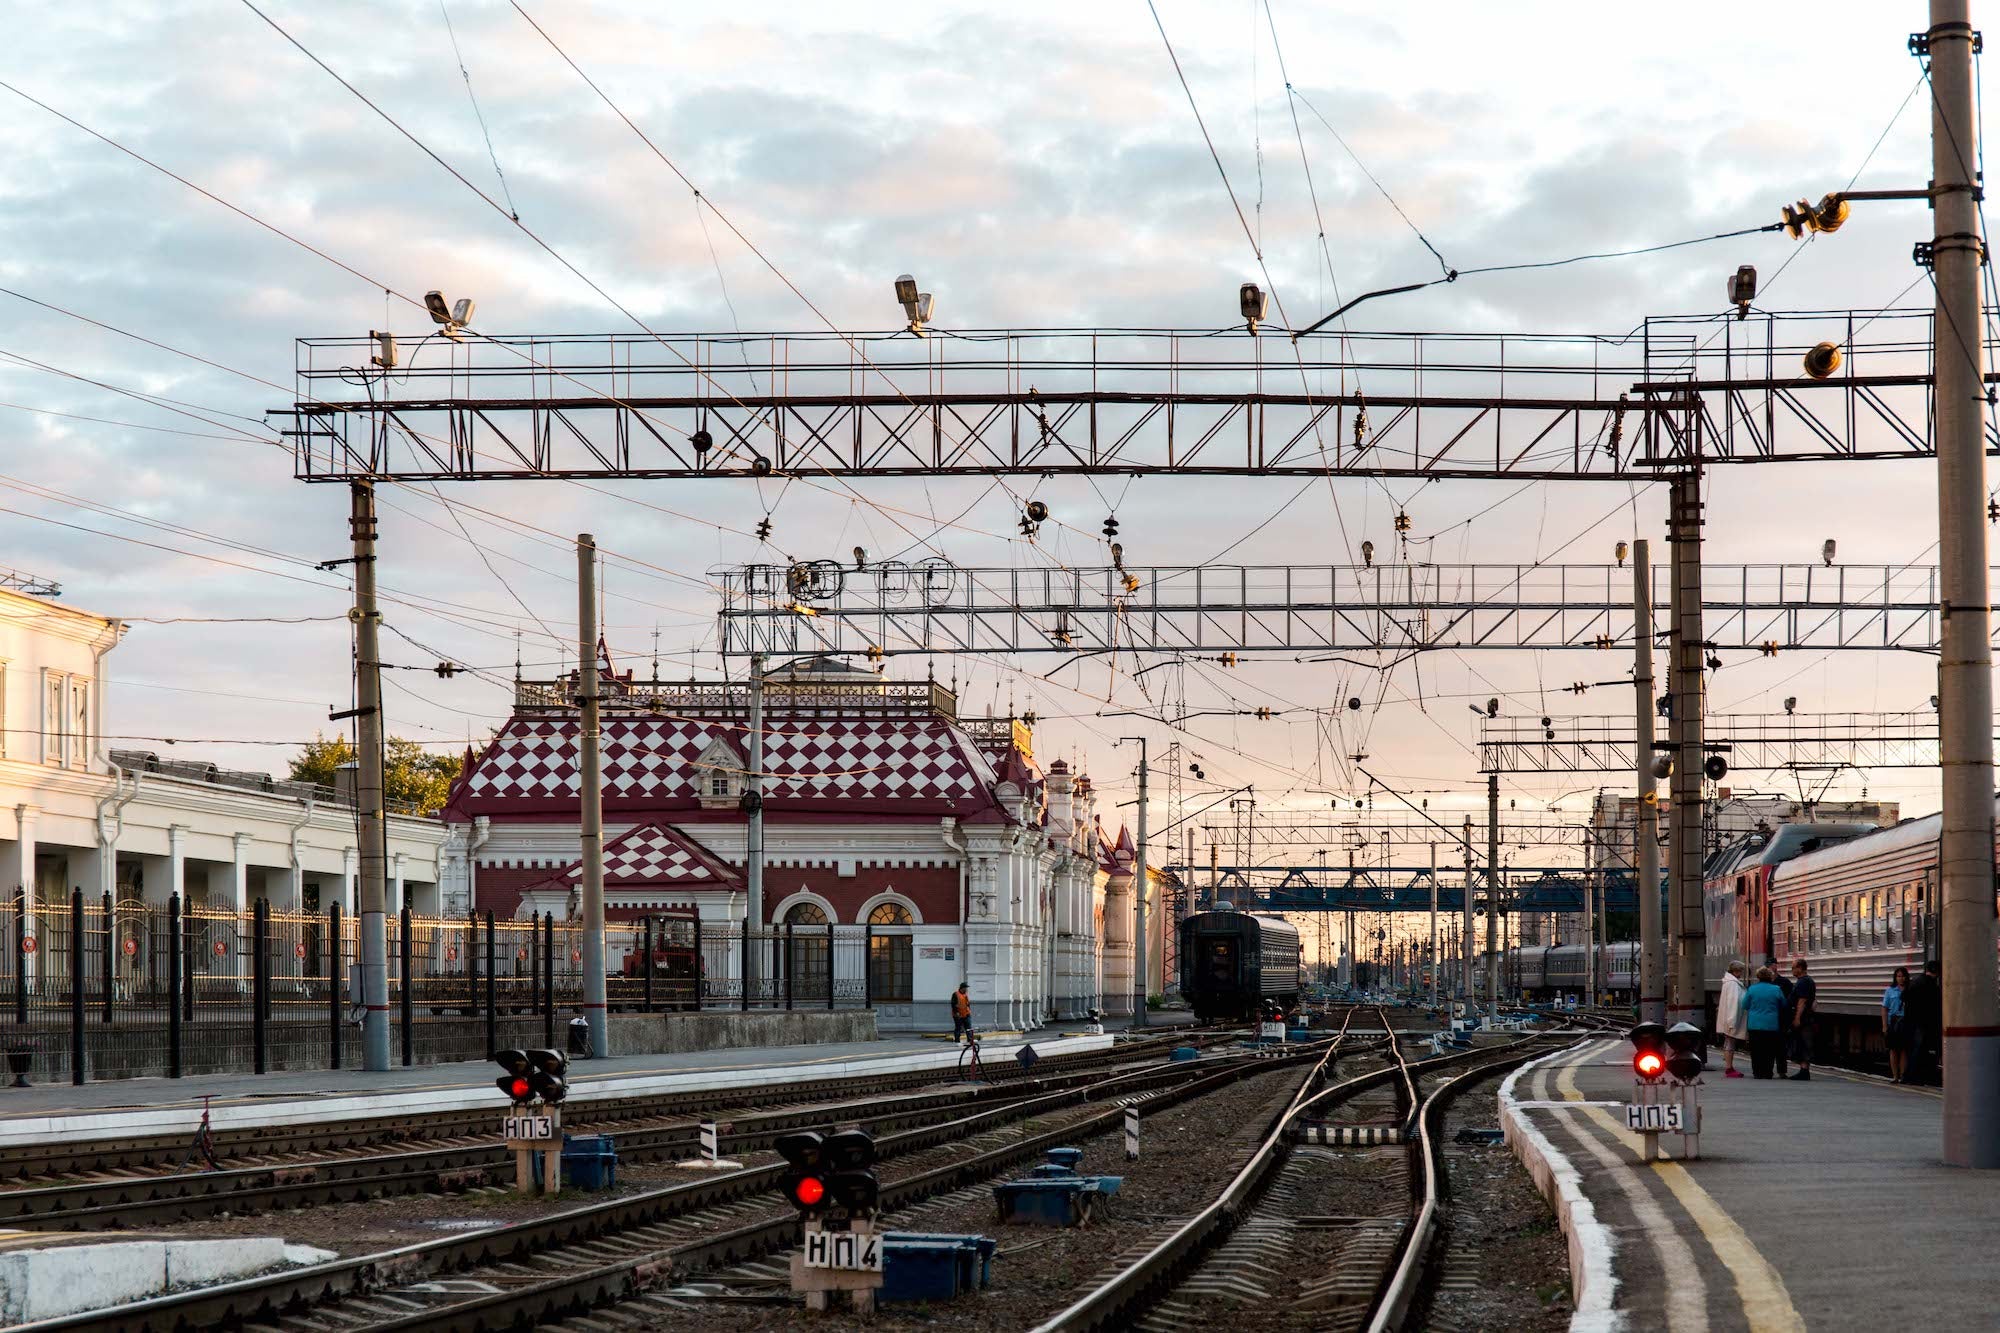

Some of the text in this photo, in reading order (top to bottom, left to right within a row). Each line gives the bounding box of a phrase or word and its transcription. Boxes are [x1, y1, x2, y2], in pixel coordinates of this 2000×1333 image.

[1629, 1106, 1678, 1127] НП5
[505, 1118, 550, 1138] НП3
[809, 1235, 877, 1268] НП4
